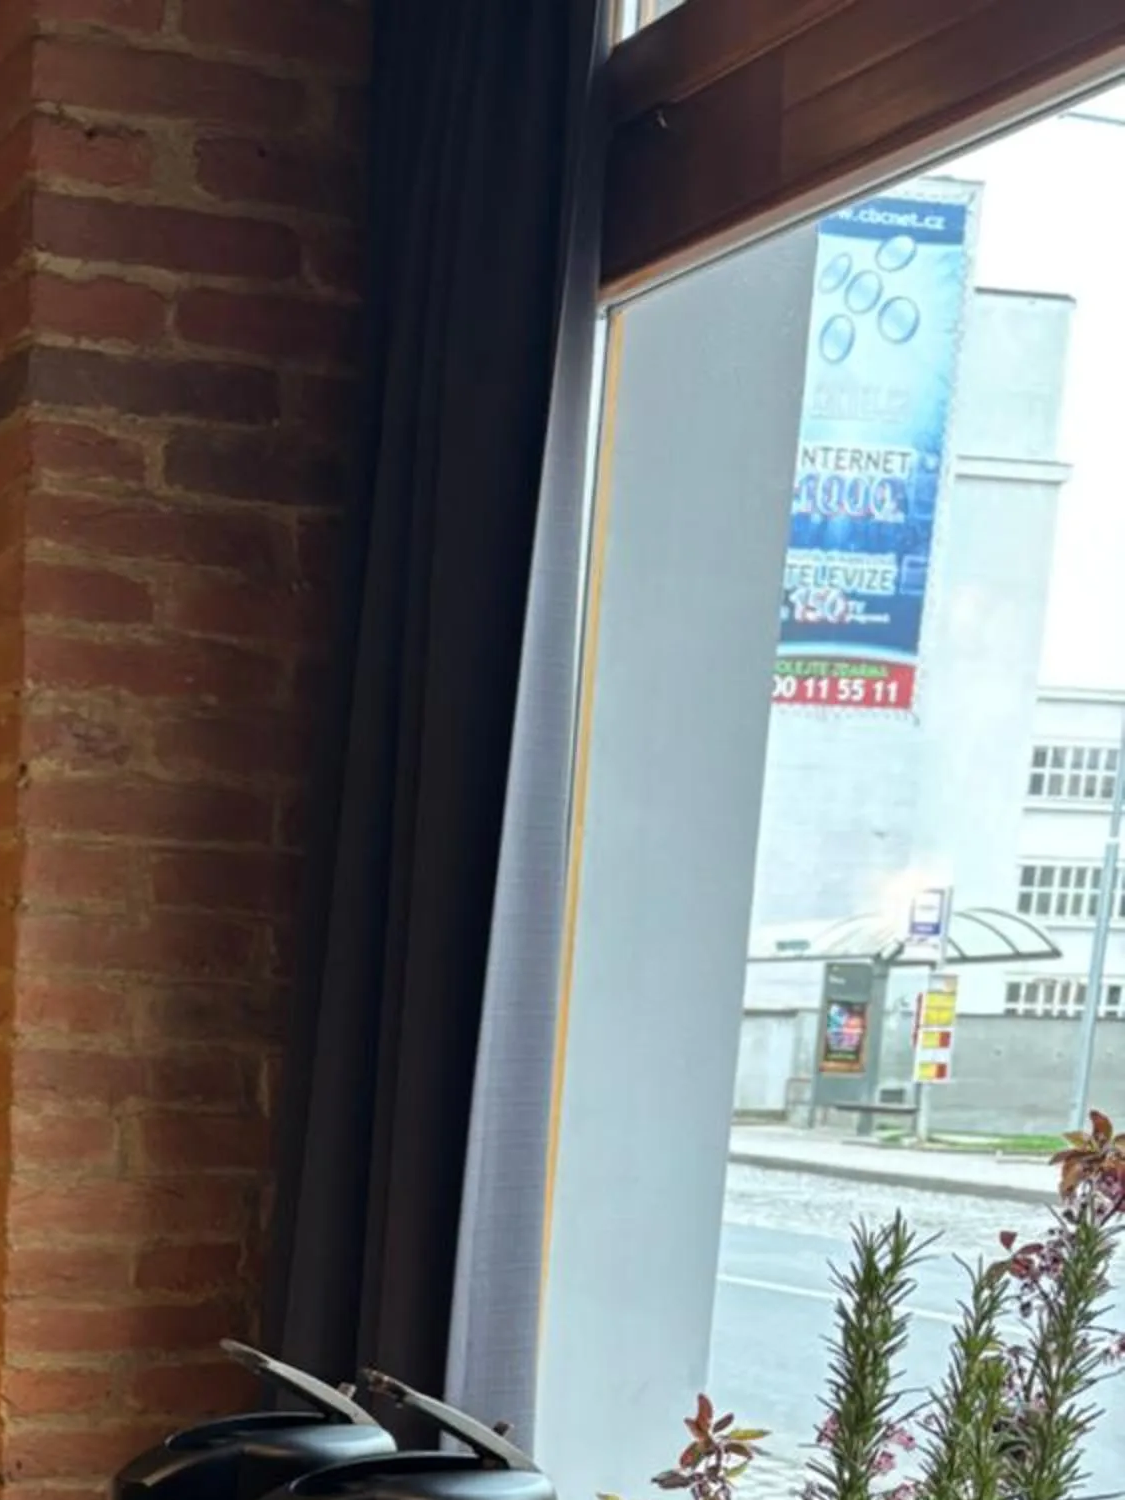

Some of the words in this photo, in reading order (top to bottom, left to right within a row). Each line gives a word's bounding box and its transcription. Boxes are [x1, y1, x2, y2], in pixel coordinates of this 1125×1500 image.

[800, 445, 912, 476] NTERNET
[786, 563, 893, 593] TELEVIZE
[802, 676, 830, 700] 11
[837, 677, 865, 702] 55
[872, 679, 899, 705] 11
